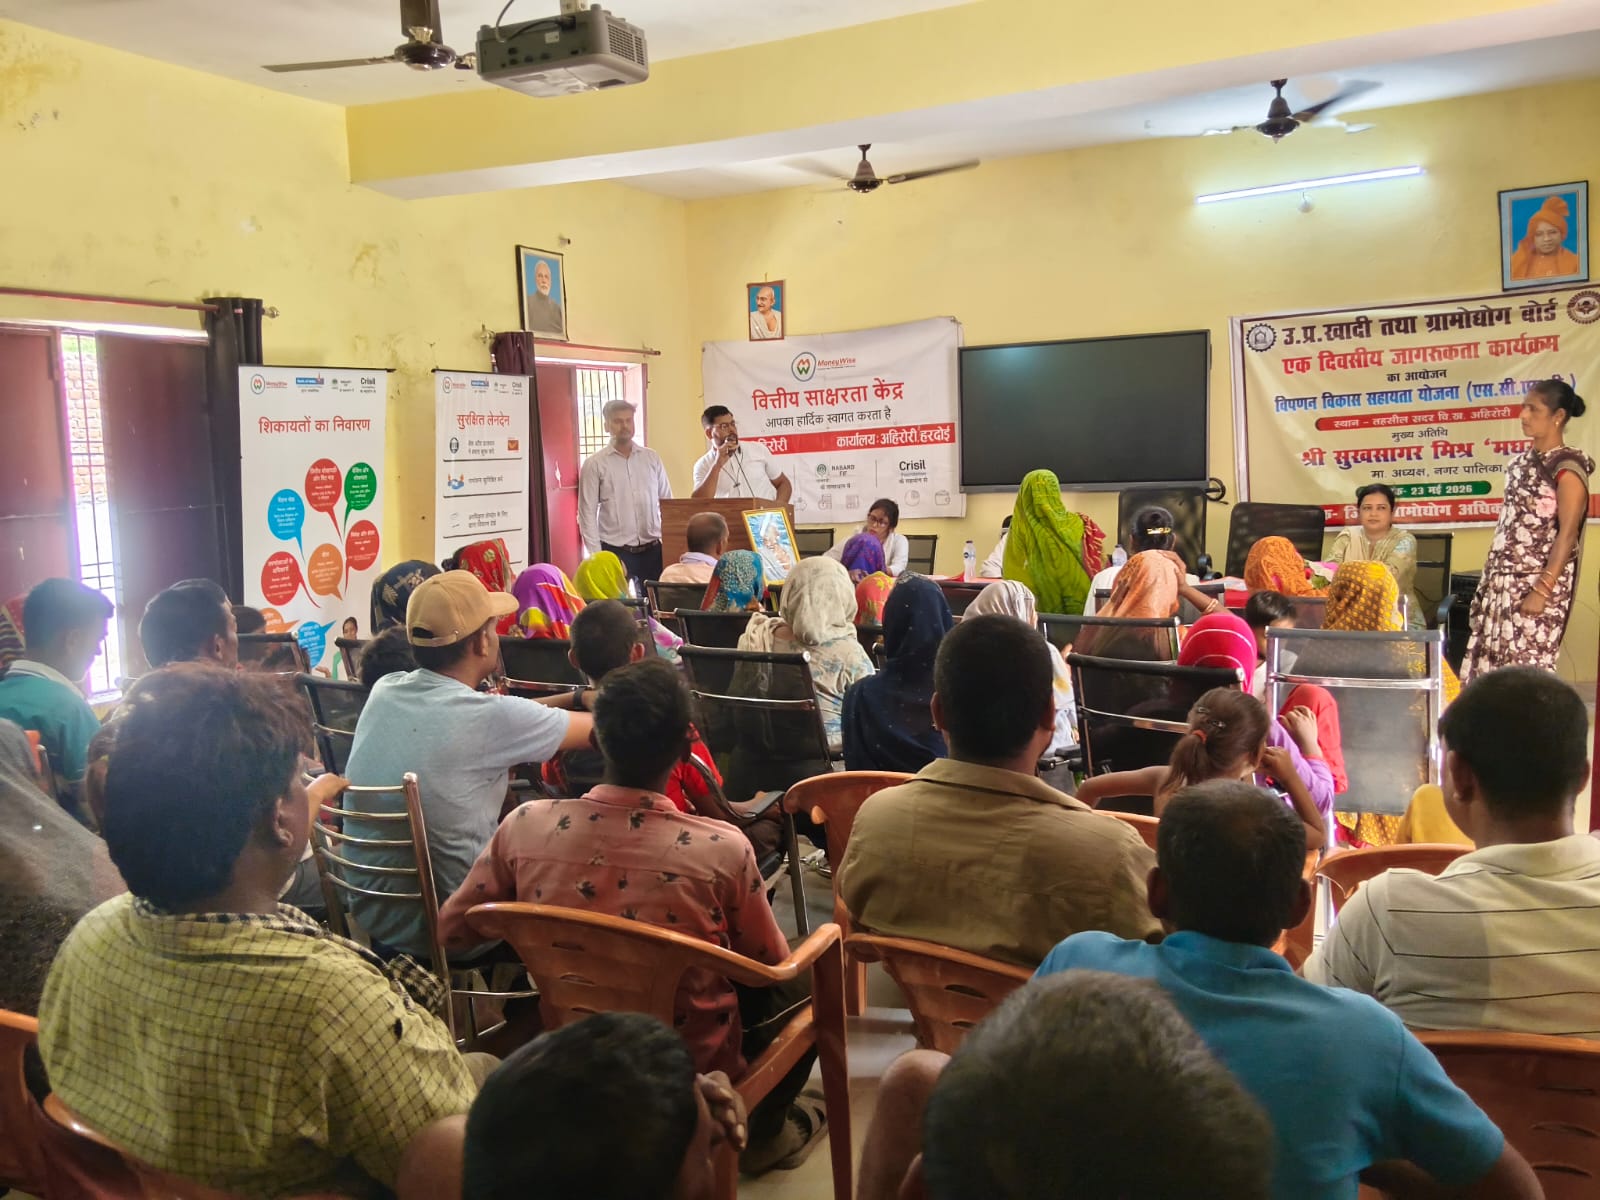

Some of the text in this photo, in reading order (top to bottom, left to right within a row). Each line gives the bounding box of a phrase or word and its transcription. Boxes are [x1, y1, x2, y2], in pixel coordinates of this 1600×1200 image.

[1379, 315, 1418, 337] तथा
[1424, 304, 1512, 333] ग्रामोद्योग
[1520, 298, 1558, 323] बोर्ड
[1282, 355, 1312, 375] एक
[1317, 347, 1384, 372] दिवसीय
[1486, 332, 1560, 357] कार्यक्रम
[1387, 368, 1447, 382] का आयोजन
[751, 377, 904, 411] वित्तीय साक्षरता केंद्र
[1275, 396, 1317, 412] विपणन
[1321, 391, 1361, 409] विकास
[1366, 388, 1413, 405] सहायता
[1417, 384, 1460, 402] योजना
[258, 415, 371, 433] शिकायतों का निवारण
[456, 410, 510, 429] सुरक्षित लेनदेन
[765, 404, 892, 428] आपका हार्दिक स्वागत करता है
[1373, 415, 1408, 426] तहसील
[1412, 413, 1434, 423] सदर
[1471, 405, 1511, 420] अहिरोरी
[920, 425, 951, 442] हरदोई
[1391, 427, 1448, 442] मुख्य अतिथि
[1301, 447, 1326, 466] श्री
[1333, 444, 1424, 470] सुखसागर
[1431, 440, 1474, 460] मिश्र
[899, 459, 926, 471] Crisil
[1434, 466, 1458, 475] नगर
[1411, 487, 1424, 496] 23
[1427, 484, 1442, 496] मई
[1445, 484, 1473, 495] 2026
